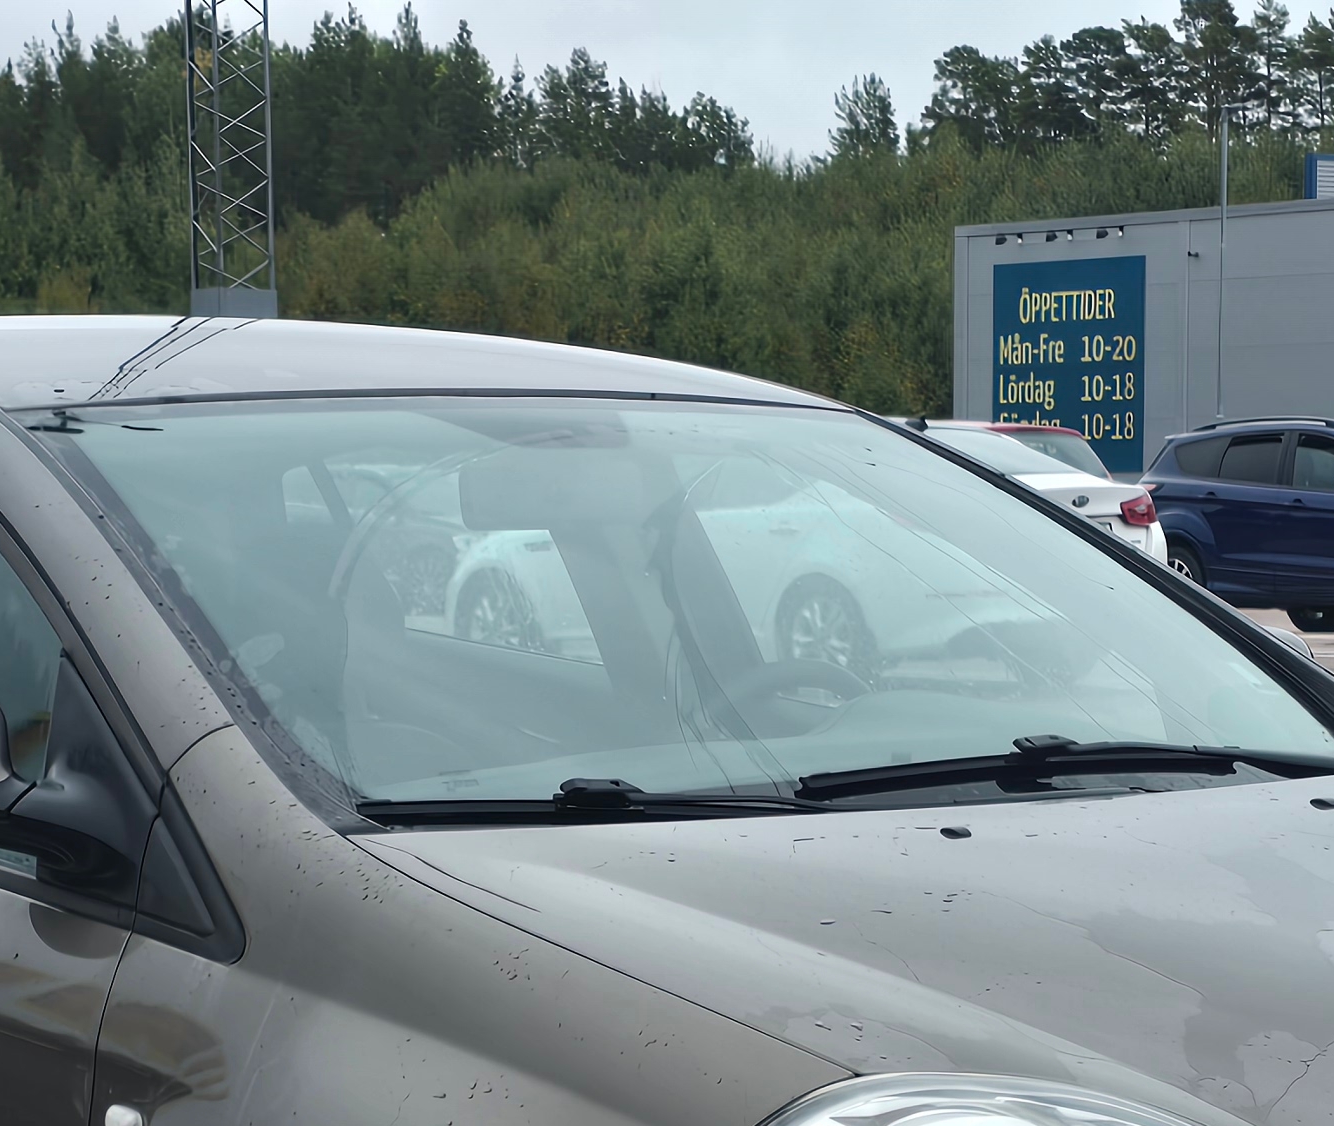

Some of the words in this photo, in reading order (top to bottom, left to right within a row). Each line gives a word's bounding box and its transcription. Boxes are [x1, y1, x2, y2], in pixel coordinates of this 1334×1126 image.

[1019, 288, 1115, 323] ÖPPETTIDER
[999, 333, 1064, 364] Mån-Fre
[1080, 335, 1136, 362] 10-20
[999, 372, 1055, 410] Lördag
[1080, 373, 1134, 401] 10-18
[1081, 411, 1134, 440] 10-18
